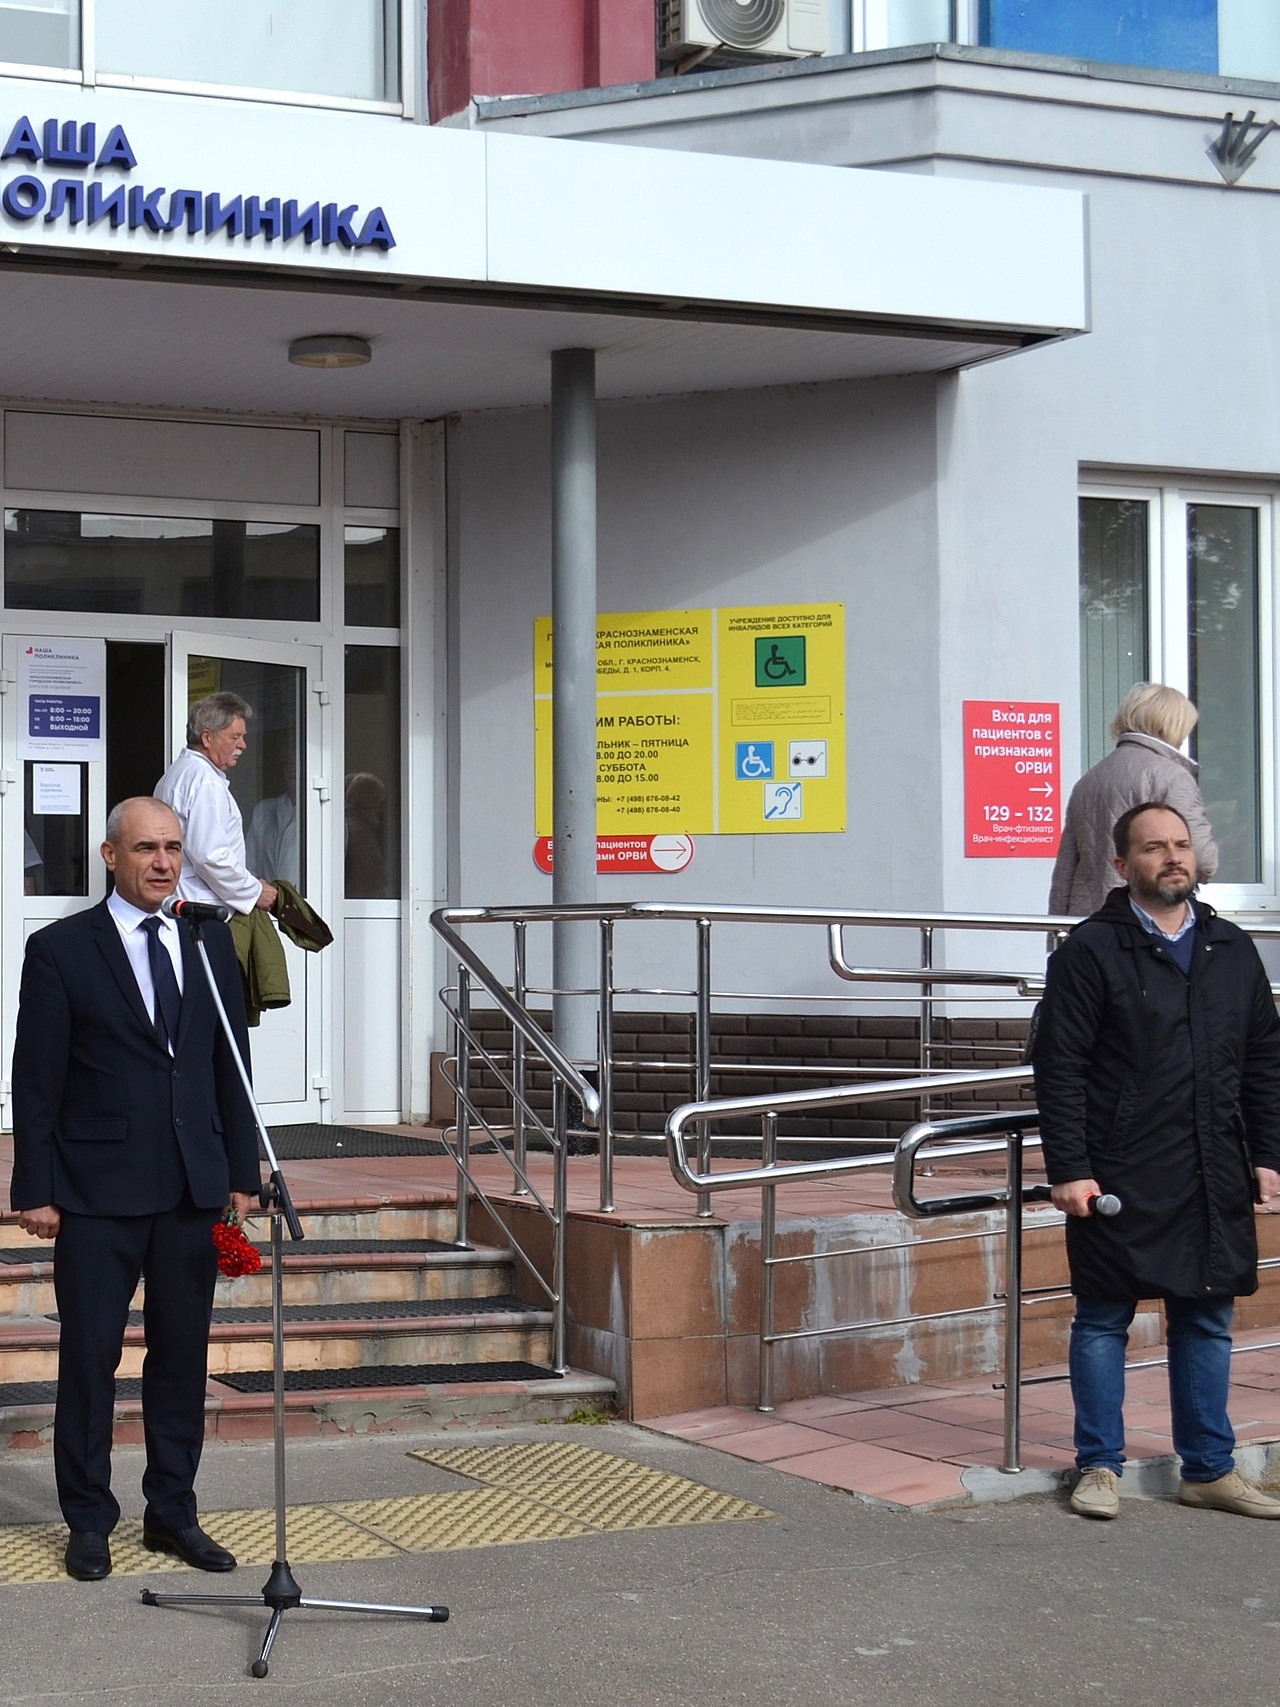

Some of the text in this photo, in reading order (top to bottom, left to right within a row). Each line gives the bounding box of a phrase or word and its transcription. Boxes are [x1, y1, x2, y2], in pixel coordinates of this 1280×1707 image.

[729, 616, 776, 624] УЧРЕЖДЕНИЕ
[777, 615, 815, 623] ДОСТУПНО
[729, 623, 770, 631] ИНВАЛИДОВ
[792, 621, 832, 629] КАТЕГОРИЙ
[614, 640, 690, 649] ПОЛИКЛИНИКА»
[627, 656, 701, 665] КРАСНОЗНАМЕНСК,
[619, 715, 680, 727] РАБОТЫ:
[992, 709, 1052, 724] Вход для
[972, 728, 1052, 740] пациентов с
[641, 739, 689, 748] ПЯТНИЦА
[596, 750, 658, 760] 8.00 ДО 20.00
[975, 745, 1052, 757] признаками
[599, 763, 646, 772] СУББОТА
[1015, 762, 1052, 774] ОРВИ
[596, 774, 659, 784] 8.00 ДО 15.00
[626, 795, 644, 803] (498)
[626, 807, 644, 815] (498)
[984, 805, 1010, 821] 129
[1027, 807, 1053, 822] 132
[993, 824, 1053, 833] Врач-фтизиатр
[972, 834, 1053, 843] Врач-инфекционист
[596, 841, 647, 850] пациентов
[618, 852, 647, 861] ОРВИ
